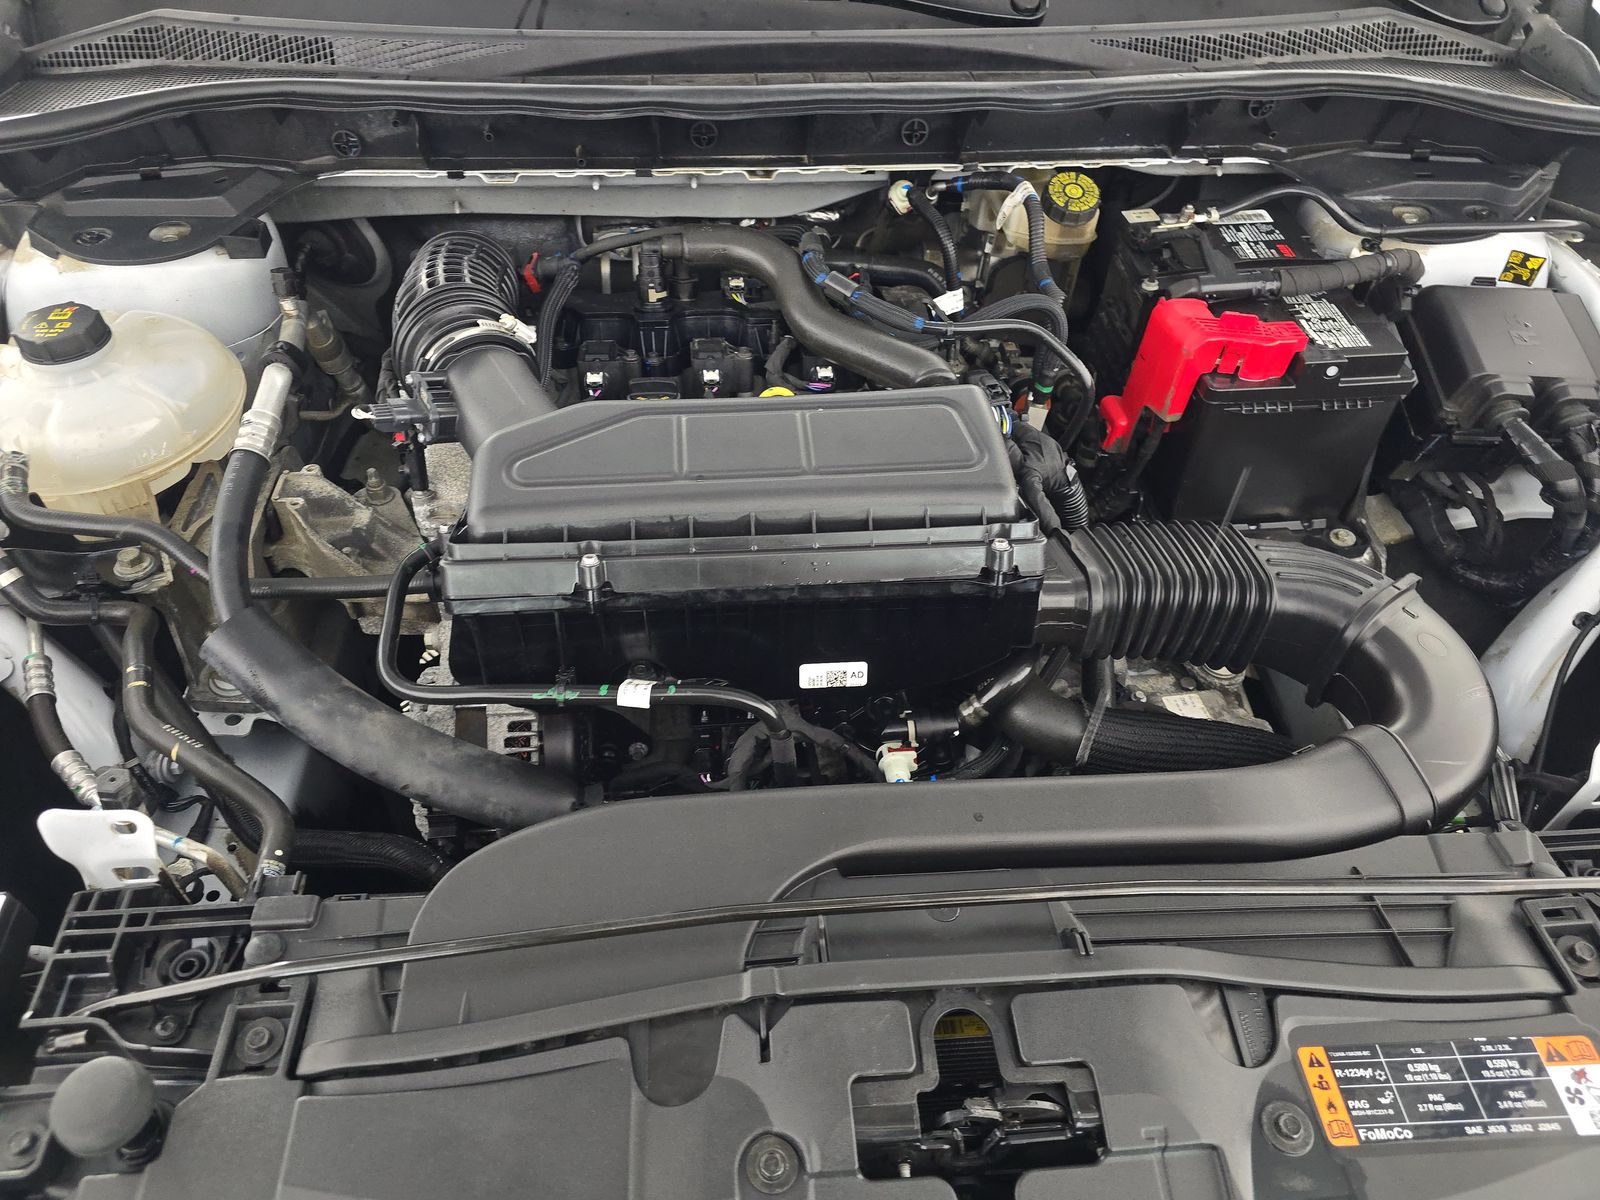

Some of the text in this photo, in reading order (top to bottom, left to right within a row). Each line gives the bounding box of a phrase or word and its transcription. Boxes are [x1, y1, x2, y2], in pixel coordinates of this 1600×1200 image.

[850, 671, 864, 679] AD
[1427, 1062, 1441, 1073] kg
[1506, 1058, 1520, 1069] kg
[1334, 1067, 1374, 1079] R-1234yf
[1427, 1093, 1446, 1102] PAG
[1508, 1090, 1526, 1099] PAG
[1347, 1099, 1370, 1109] PAG
[1358, 1127, 1414, 1141] FoMoCo
[1464, 1125, 1485, 1135] SAE
